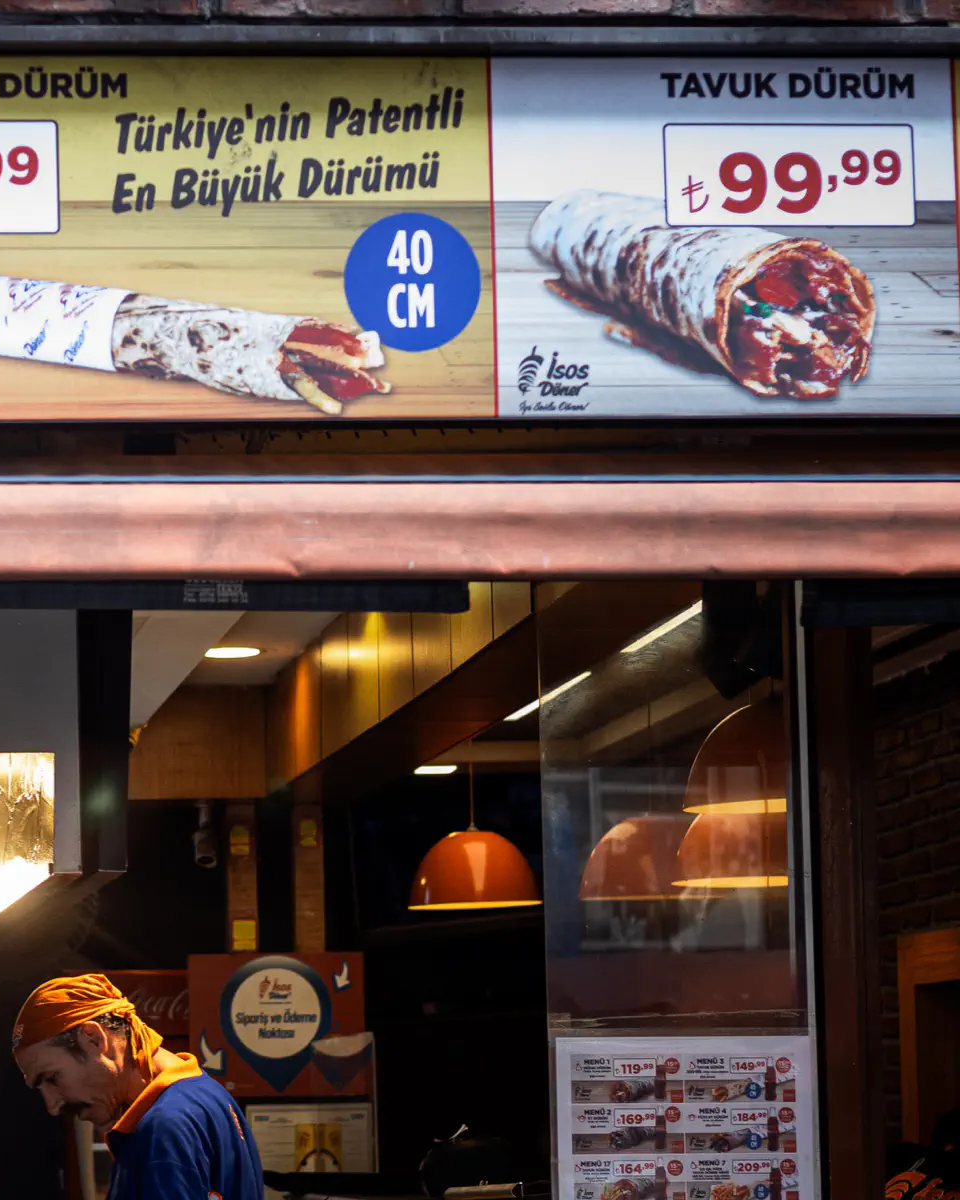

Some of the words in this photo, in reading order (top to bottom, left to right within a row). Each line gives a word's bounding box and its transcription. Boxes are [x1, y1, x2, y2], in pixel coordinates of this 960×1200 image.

[661, 73, 777, 98] TAVUK
[789, 67, 915, 99] DÜRÜM
[115, 101, 310, 159] Türkiye'nin
[326, 87, 464, 138] Patentli
[112, 172, 156, 214] En
[171, 158, 284, 217] Büyük
[298, 152, 439, 198] Dürümü
[387, 230, 432, 276] 40
[387, 289, 434, 329] CM
[547, 351, 589, 379] İsos
[538, 381, 589, 396] Döner
[236, 1012, 268, 1027] Sipariş
[283, 1008, 317, 1023] Ödeme
